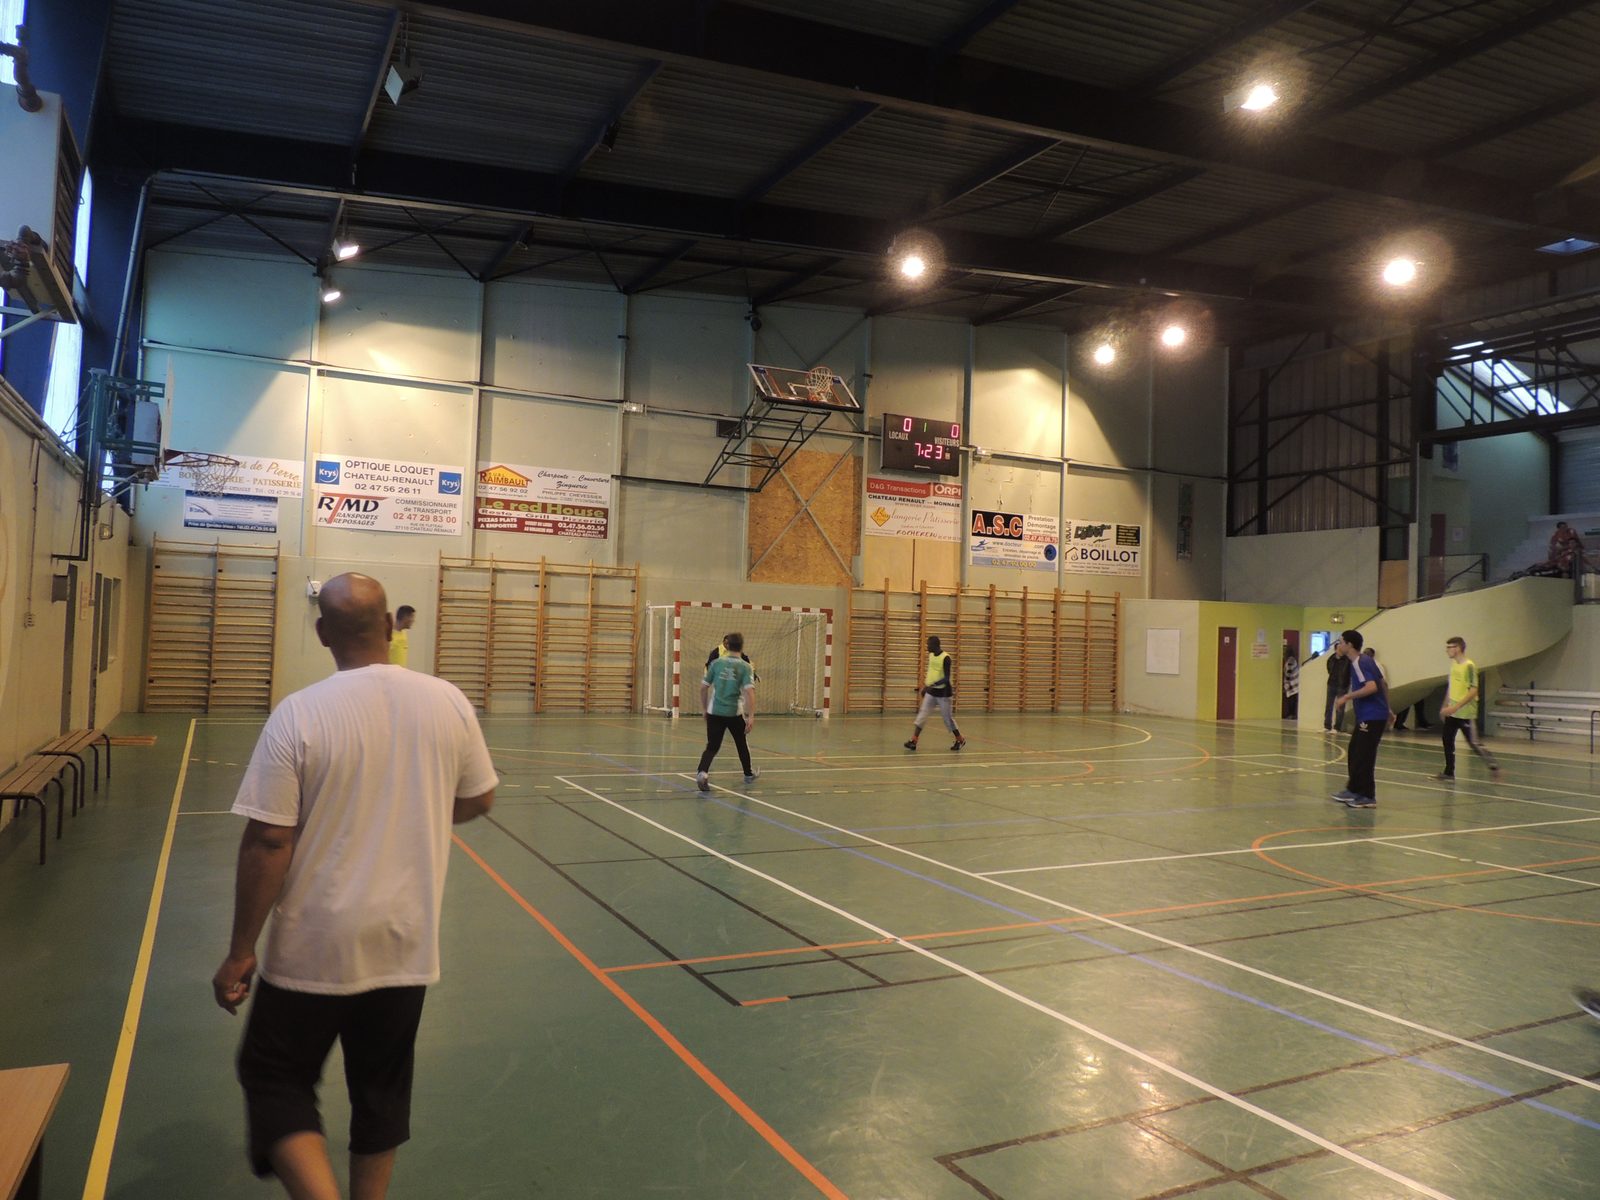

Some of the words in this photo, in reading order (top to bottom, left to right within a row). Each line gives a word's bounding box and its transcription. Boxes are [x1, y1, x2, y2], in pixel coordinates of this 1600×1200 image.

[888, 431, 909, 441] LOCAUX
[934, 436, 960, 448] VISITEURS
[250, 460, 262, 471] de
[266, 461, 300, 480] Pierre
[319, 468, 337, 478] Krys
[345, 460, 390, 472] OPTIQUE
[394, 464, 435, 476] LOQUET
[344, 472, 435, 486] CHATEAU-RENAULT
[537, 470, 569, 480] Charpente
[578, 474, 610, 484] Couverture
[354, 483, 367, 491] 02
[369, 484, 381, 492] 47
[383, 485, 396, 493] 56
[398, 486, 410, 494] 26
[412, 487, 422, 495] 11
[441, 479, 458, 489] Krys
[556, 480, 588, 490] Zinguerie
[869, 482, 885, 490] D&G
[886, 484, 926, 495] Transactions
[934, 484, 961, 496] ORPI
[395, 498, 458, 509] COMMISSIONNAIRE
[868, 494, 897, 502] CHATEAU
[898, 496, 925, 504] RENAULT
[413, 507, 452, 515] TRANSPORT
[480, 497, 505, 510] Le
[509, 499, 542, 513] red
[546, 502, 605, 518] House
[393, 512, 404, 520] 02
[406, 513, 418, 521] 47
[419, 514, 431, 522] 29
[433, 515, 444, 523] 83
[446, 516, 457, 524] 00
[972, 513, 1023, 537] A.S.C
[1080, 548, 1139, 563] BOILLOT
